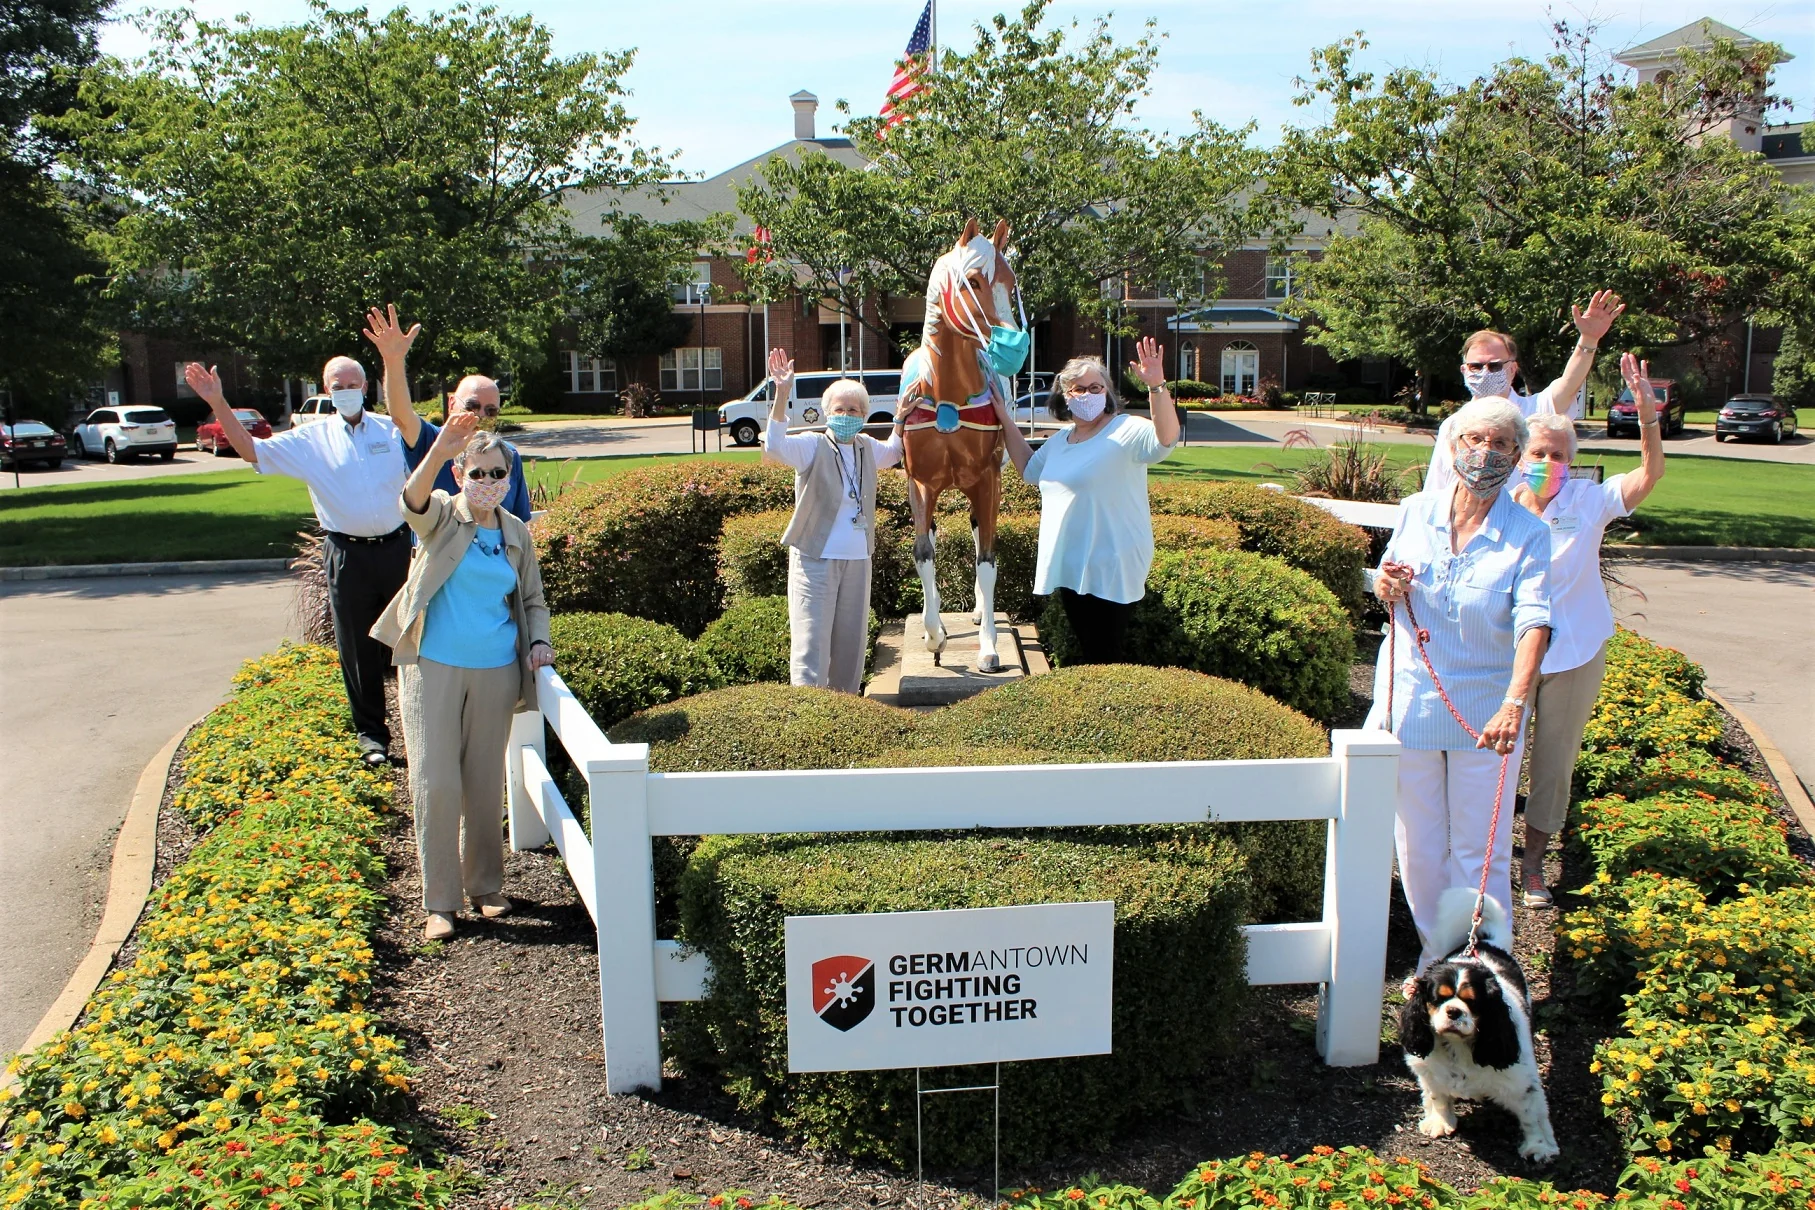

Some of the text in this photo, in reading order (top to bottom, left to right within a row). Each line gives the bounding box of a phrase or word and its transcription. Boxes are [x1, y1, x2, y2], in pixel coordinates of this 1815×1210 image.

[889, 944, 1088, 977] GERMANTOWN
[889, 974, 1021, 1003] FIGHTING
[889, 999, 1038, 1028] TOGETHER
